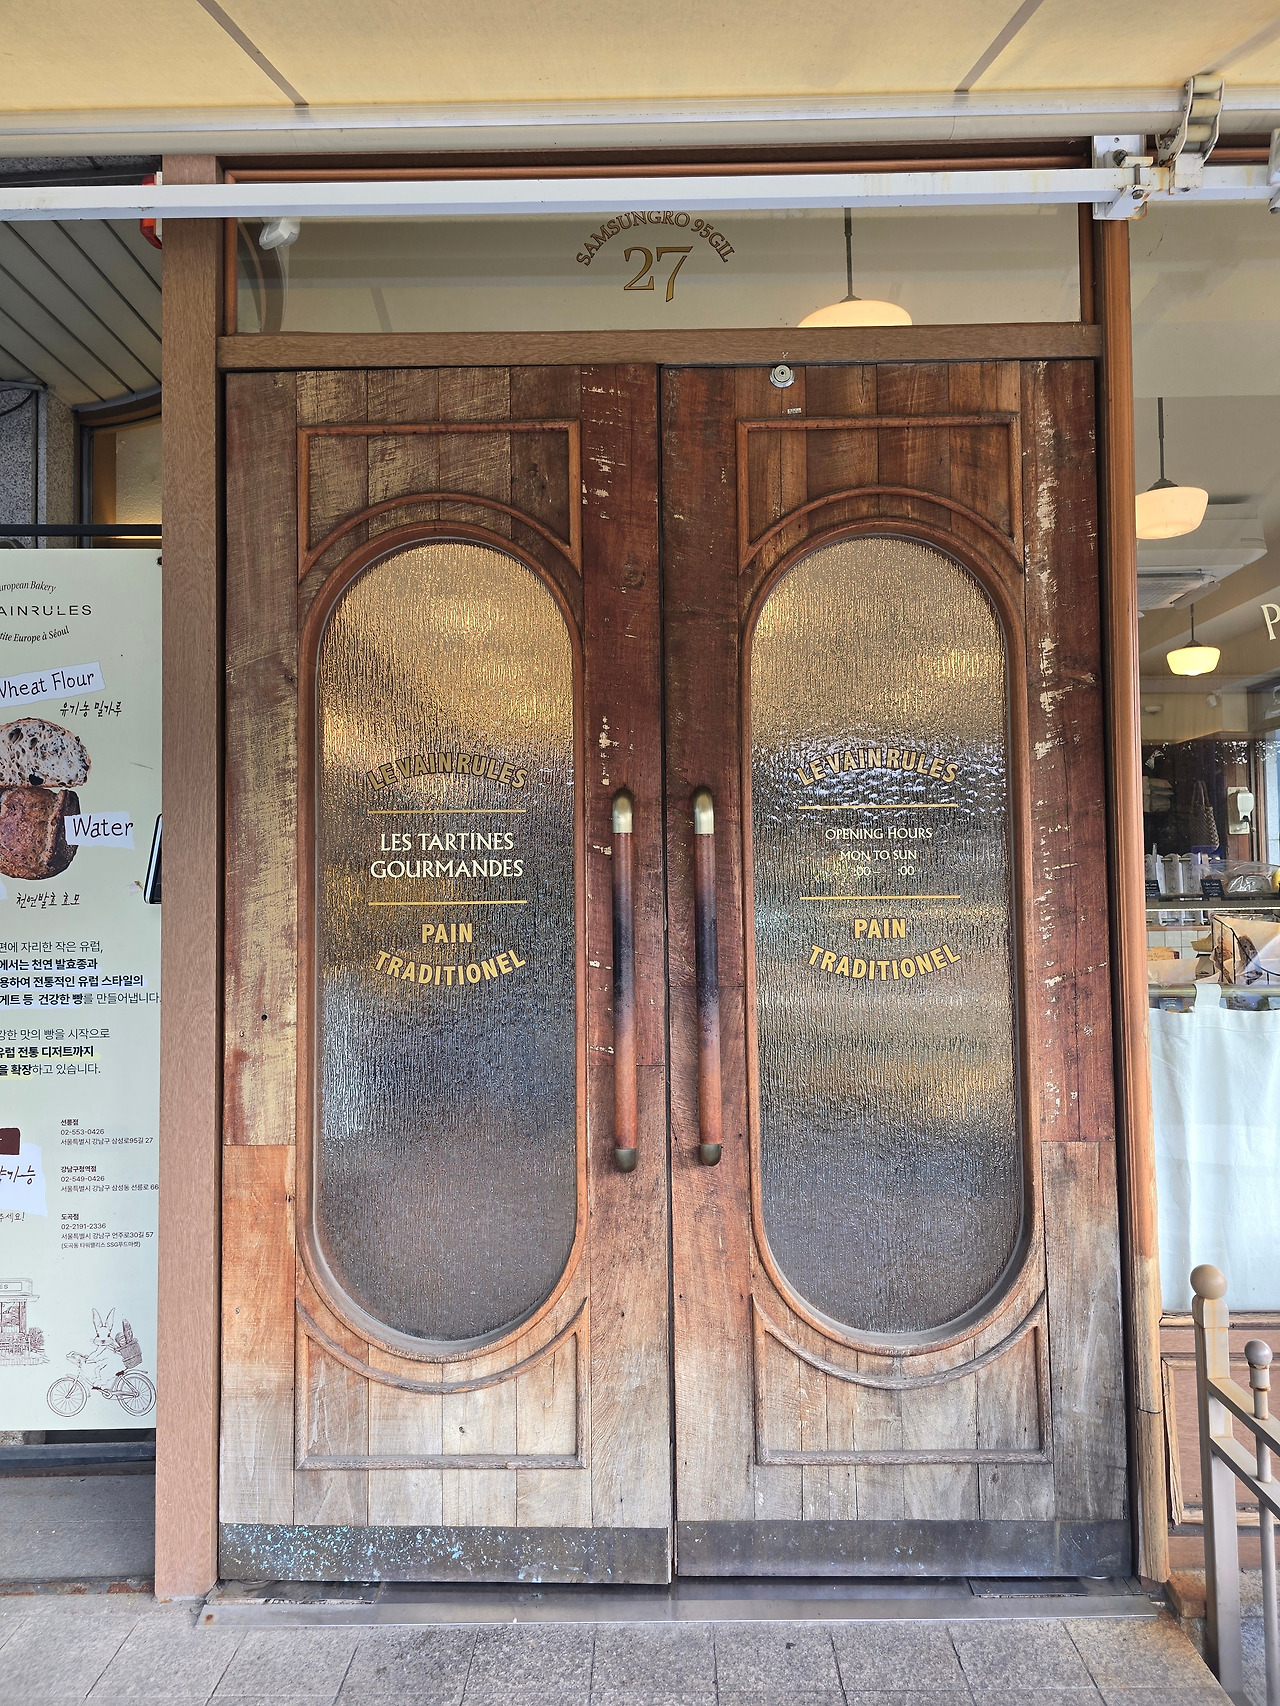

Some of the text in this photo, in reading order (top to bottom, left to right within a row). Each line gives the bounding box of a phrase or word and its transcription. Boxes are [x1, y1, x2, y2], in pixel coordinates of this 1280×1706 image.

[575, 210, 735, 267] SAMSUNGRO 95GIL
[623, 246, 694, 303] 27
[30, 580, 57, 595] Bakery
[13, 633, 41, 644] Europe
[41, 631, 48, 641] à
[48, 625, 70, 640] Séoul
[51, 670, 94, 691] Flour
[60, 700, 122, 717] 유기농 밀가루
[73, 815, 134, 838] Water
[825, 827, 933, 840] OPENING HOURS
[381, 832, 514, 852] LES TARTINES
[840, 849, 917, 861] MON TO SUN
[370, 859, 524, 879] GOURMANDES
[421, 923, 473, 944] PAIN
[854, 918, 906, 939] PAIN
[21, 941, 53, 953] 자리한
[55, 941, 77, 952] 작은
[80, 940, 103, 953] 유럽,
[32, 959, 53, 970] 천연
[55, 958, 98, 970] 발효종과
[375, 949, 526, 986] TRADITIONEL
[808, 944, 961, 981] TRADITIONEL
[33, 976, 75, 988] 전통적인
[78, 976, 99, 987] 유럽
[101, 975, 143, 987] 스타일의
[23, 994, 33, 1005] 등
[38, 993, 70, 1005] 건강한
[72, 993, 93, 1004] 빵을
[96, 992, 162, 1004] 만들어냅니다.
[20, 1029, 41, 1040] 맛의
[44, 1029, 65, 1040] 빵을
[68, 1028, 110, 1039] 시작으로
[18, 1046, 39, 1058] 전통
[41, 1045, 94, 1058] 디저트까지
[10, 1063, 53, 1075] 확장하고
[56, 1063, 101, 1075] 있습니다.
[60, 1128, 105, 1136] 02-553-0426
[60, 1138, 91, 1146] 서울특별시
[111, 1137, 144, 1145] 삼성로95길
[60, 1175, 105, 1183] 02-549-0426
[60, 1185, 91, 1193] 서울특별시
[111, 1184, 130, 1192] 삼성동
